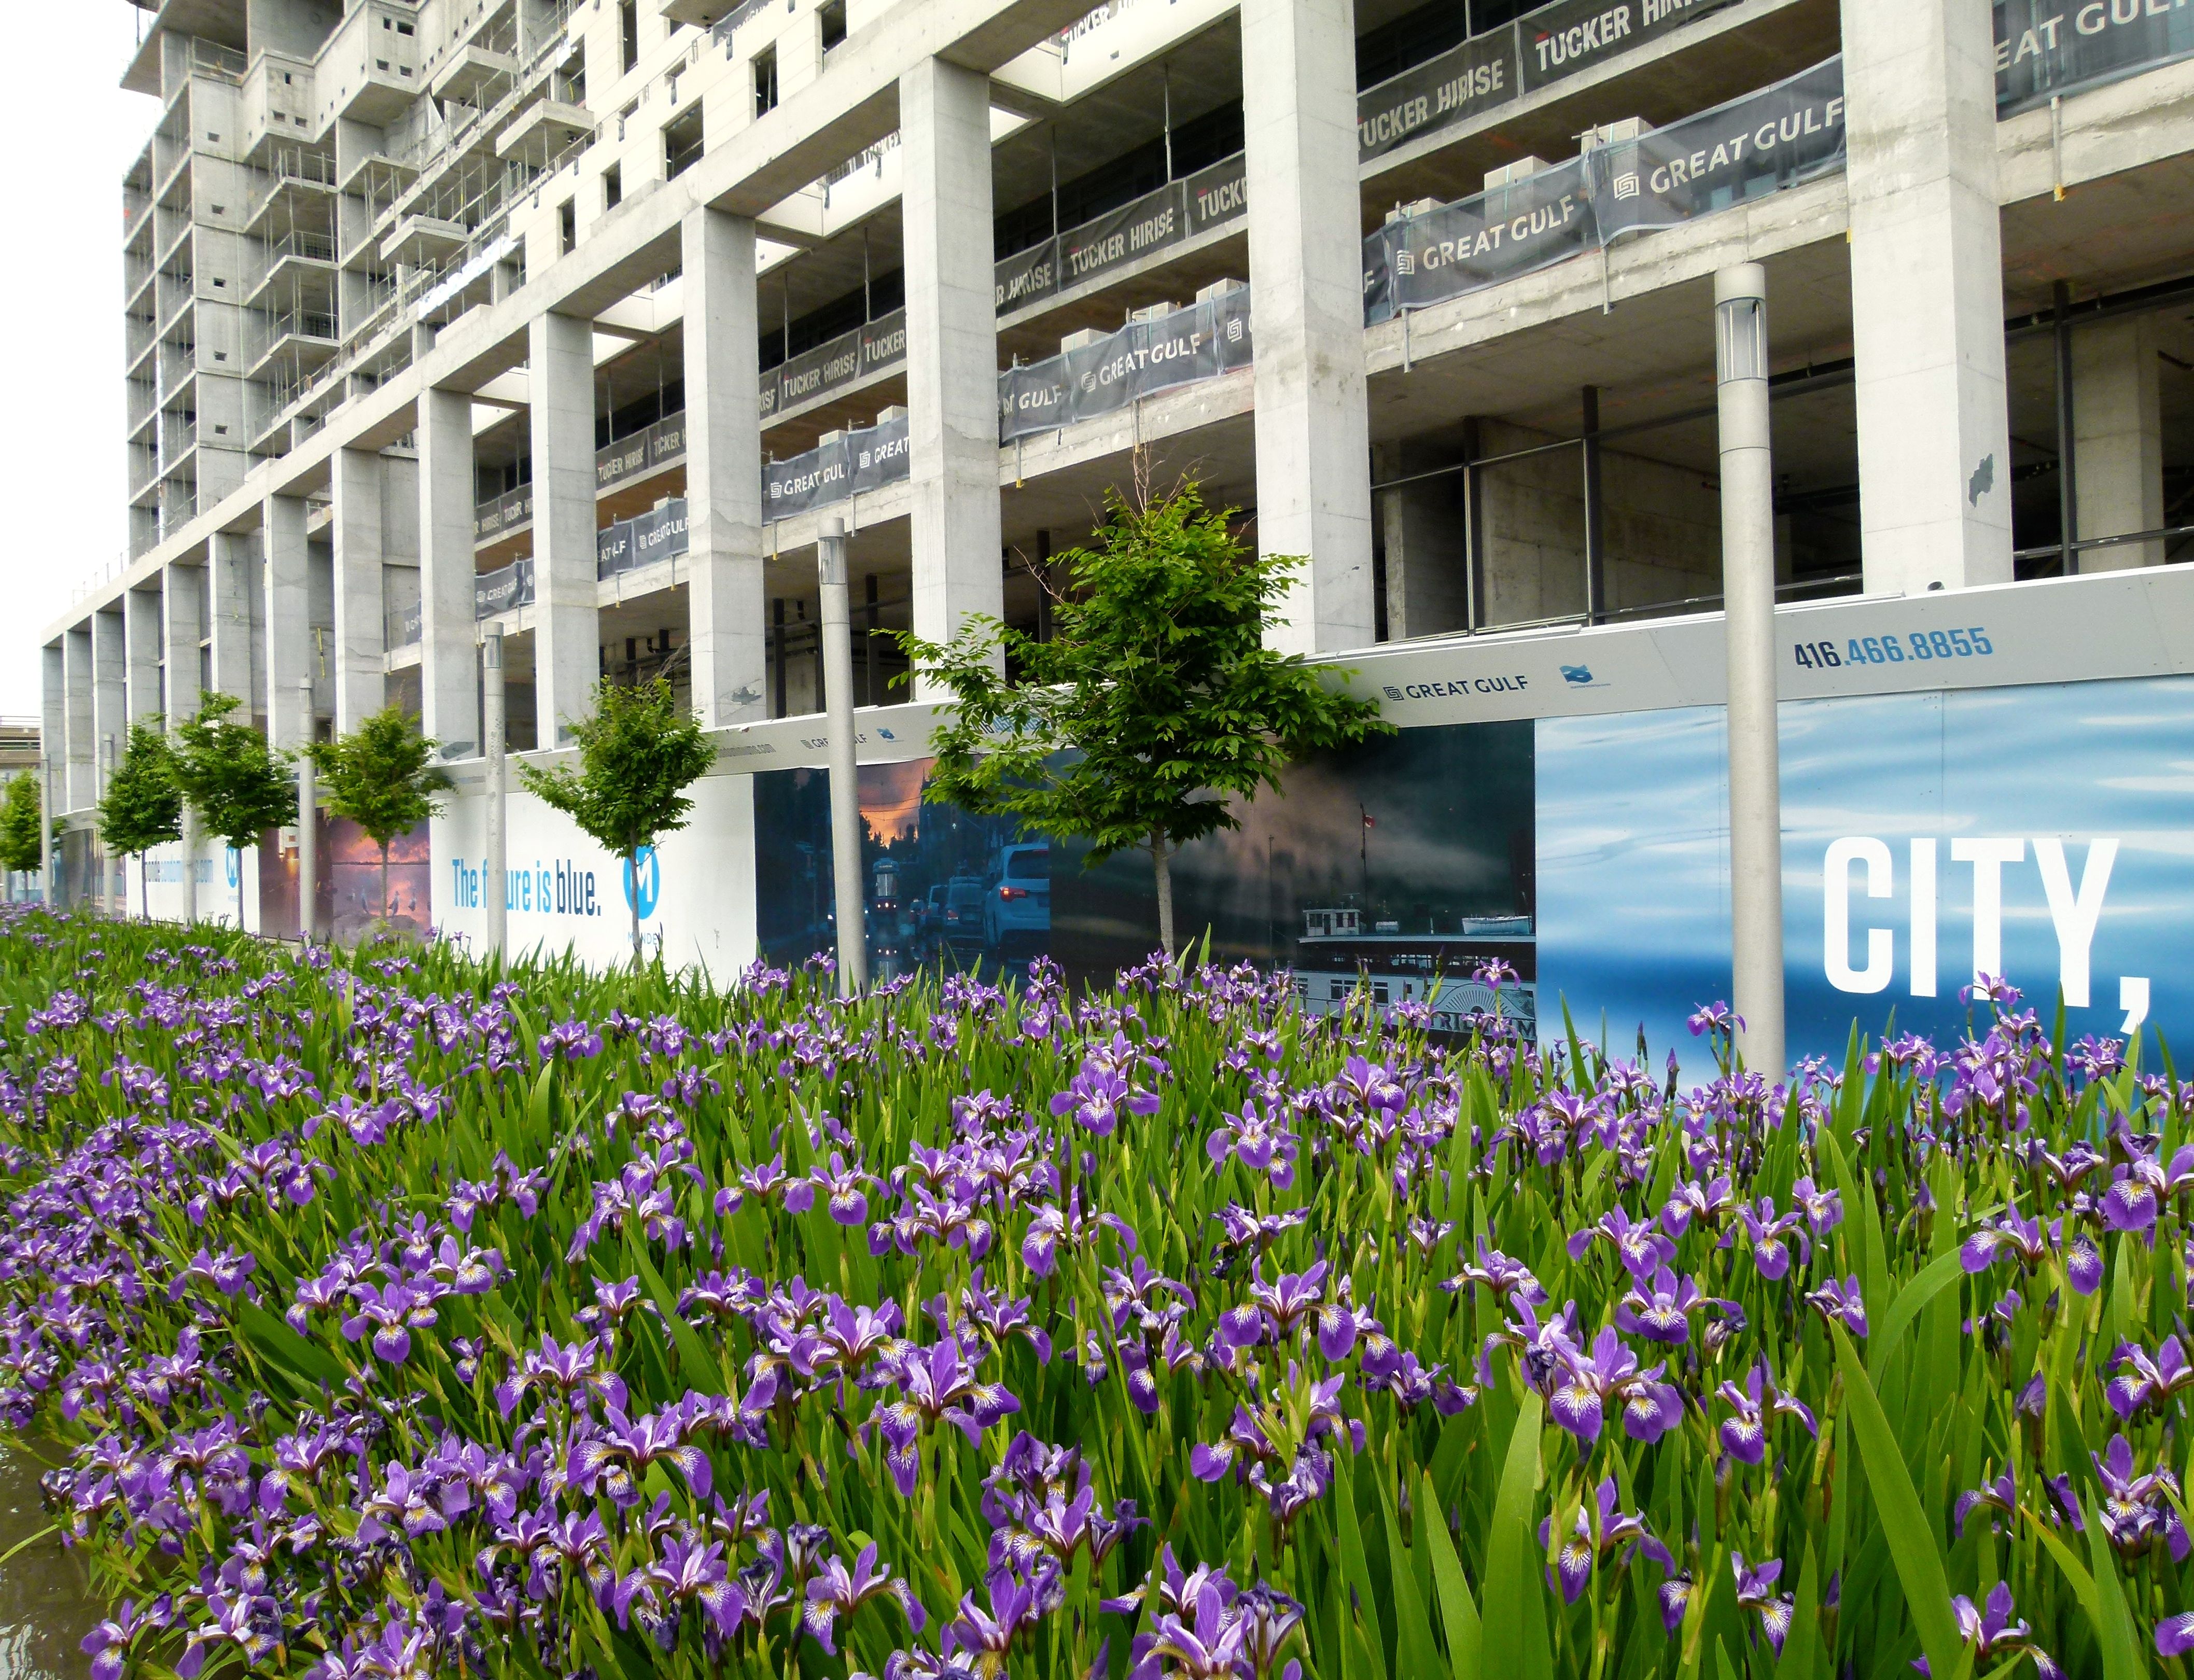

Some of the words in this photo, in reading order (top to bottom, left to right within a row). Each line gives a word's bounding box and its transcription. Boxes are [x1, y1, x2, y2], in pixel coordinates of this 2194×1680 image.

[2075, 0, 2194, 35] GUL
[1535, 6, 1631, 72] TUCKER
[1437, 59, 1503, 113] HIRISE
[1650, 133, 1749, 194] GREAT
[1754, 96, 1843, 150] GULF
[1070, 234, 1124, 275] TUCKER
[1130, 208, 1173, 250] HIRISE
[1423, 224, 1505, 270] GREAT
[1511, 194, 1574, 241] GULF
[865, 329, 906, 362] TUCKER
[1100, 349, 1149, 385] GREAT
[1151, 333, 1200, 364] GULF
[784, 369, 820, 398] TUCKER
[1018, 384, 1062, 410] GULF
[874, 437, 909, 463] GREAT
[784, 470, 820, 495] GREAT
[649, 525, 666, 546] GREAT
[1794, 627, 1993, 669] 416.466.8855
[1406, 680, 1470, 699] GREAT
[1474, 675, 1528, 692] GULF
[452, 859, 478, 908] The
[482, 858, 530, 912] fure
[536, 860, 551, 913] is
[556, 859, 602, 916] blue.
[1824, 836, 2150, 1035] CITY,
